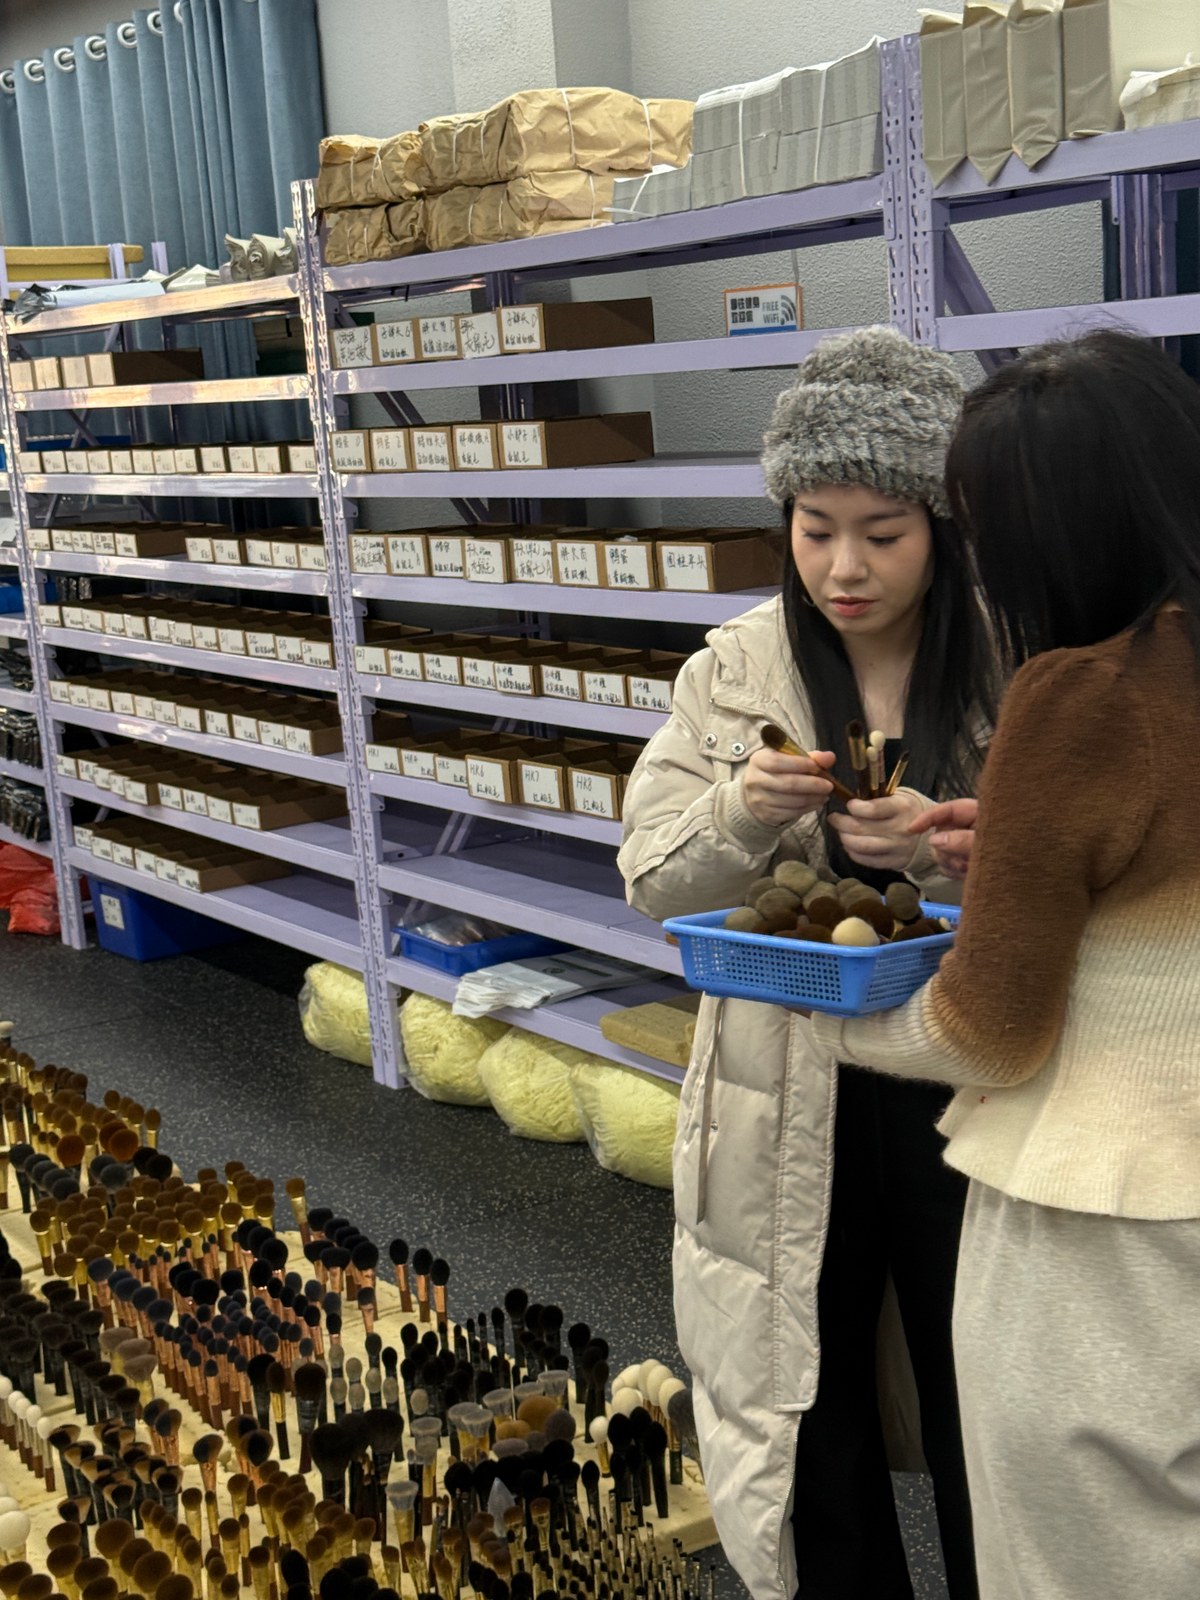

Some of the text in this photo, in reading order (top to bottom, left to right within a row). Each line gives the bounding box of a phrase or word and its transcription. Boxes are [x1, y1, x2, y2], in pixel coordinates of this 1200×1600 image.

[762, 301, 779, 311] FREE
[470, 763, 485, 778] HK6
[524, 769, 540, 783] HK7
[576, 776, 593, 792] HK8
